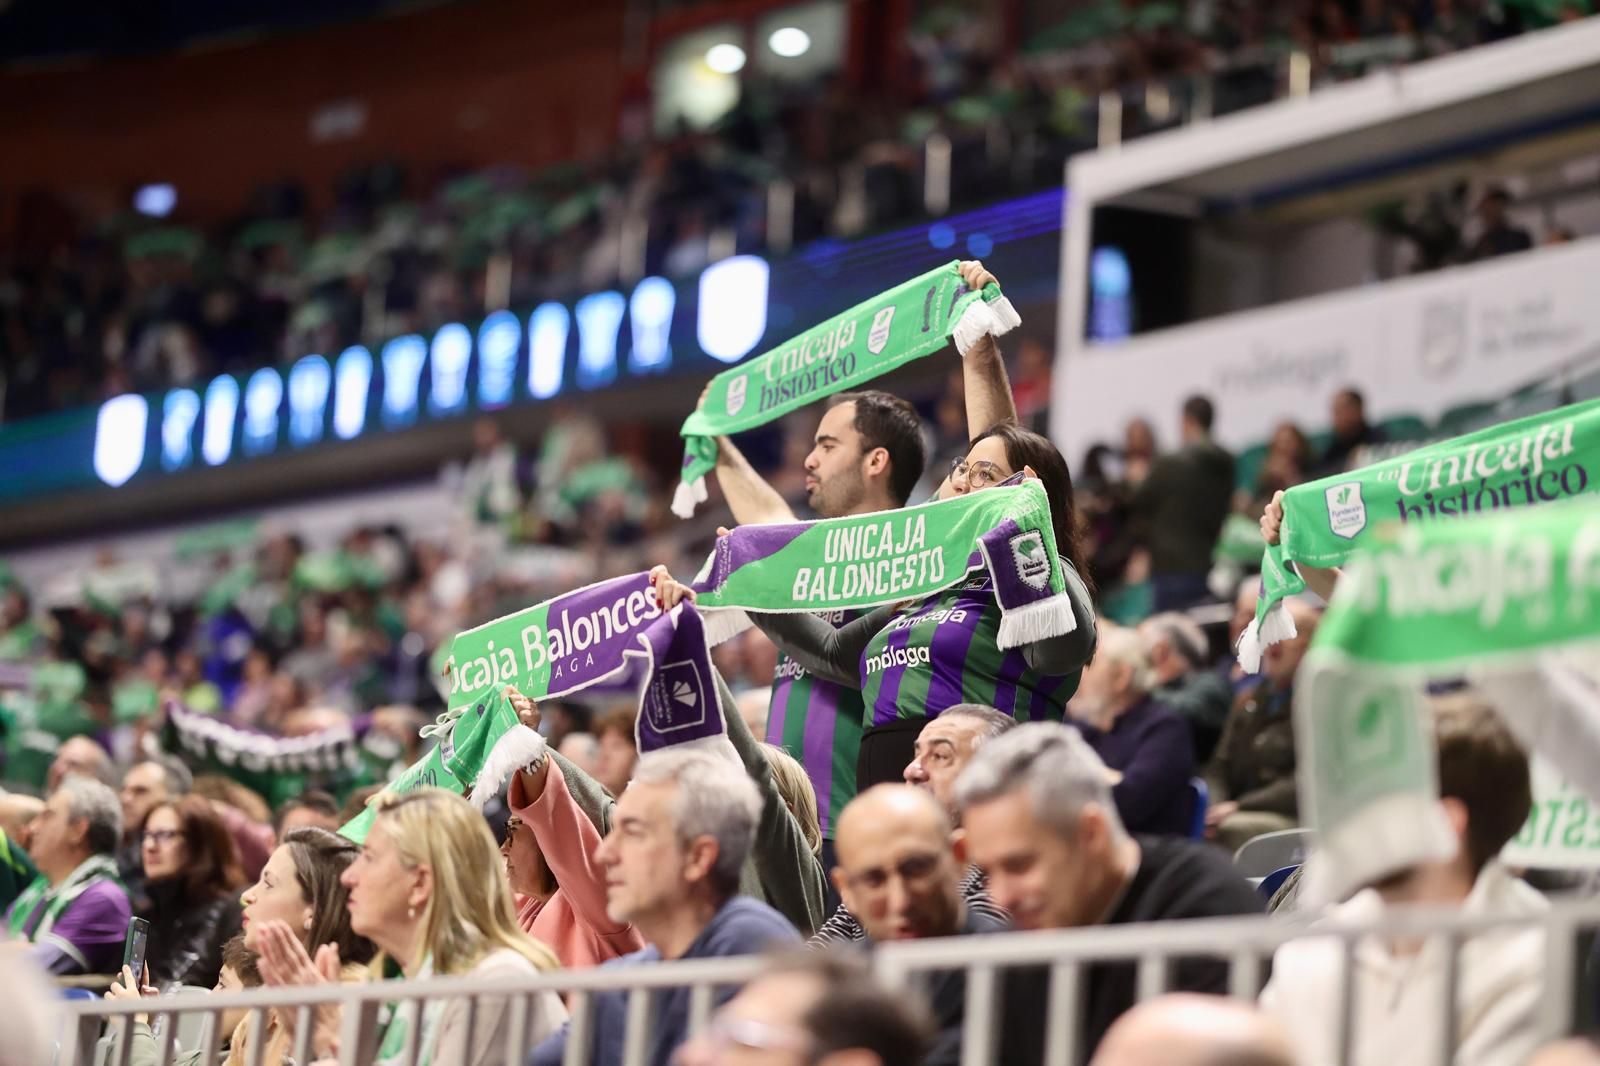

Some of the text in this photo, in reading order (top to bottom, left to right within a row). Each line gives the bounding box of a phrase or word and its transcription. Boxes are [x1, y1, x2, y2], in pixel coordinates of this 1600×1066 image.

[764, 319, 857, 382] Unicaja
[759, 352, 856, 412] histórico
[1398, 422, 1574, 496] Unicaja
[824, 514, 926, 563] UNICAJA
[792, 546, 945, 601] BALONCESTO
[866, 645, 930, 675] málaga
